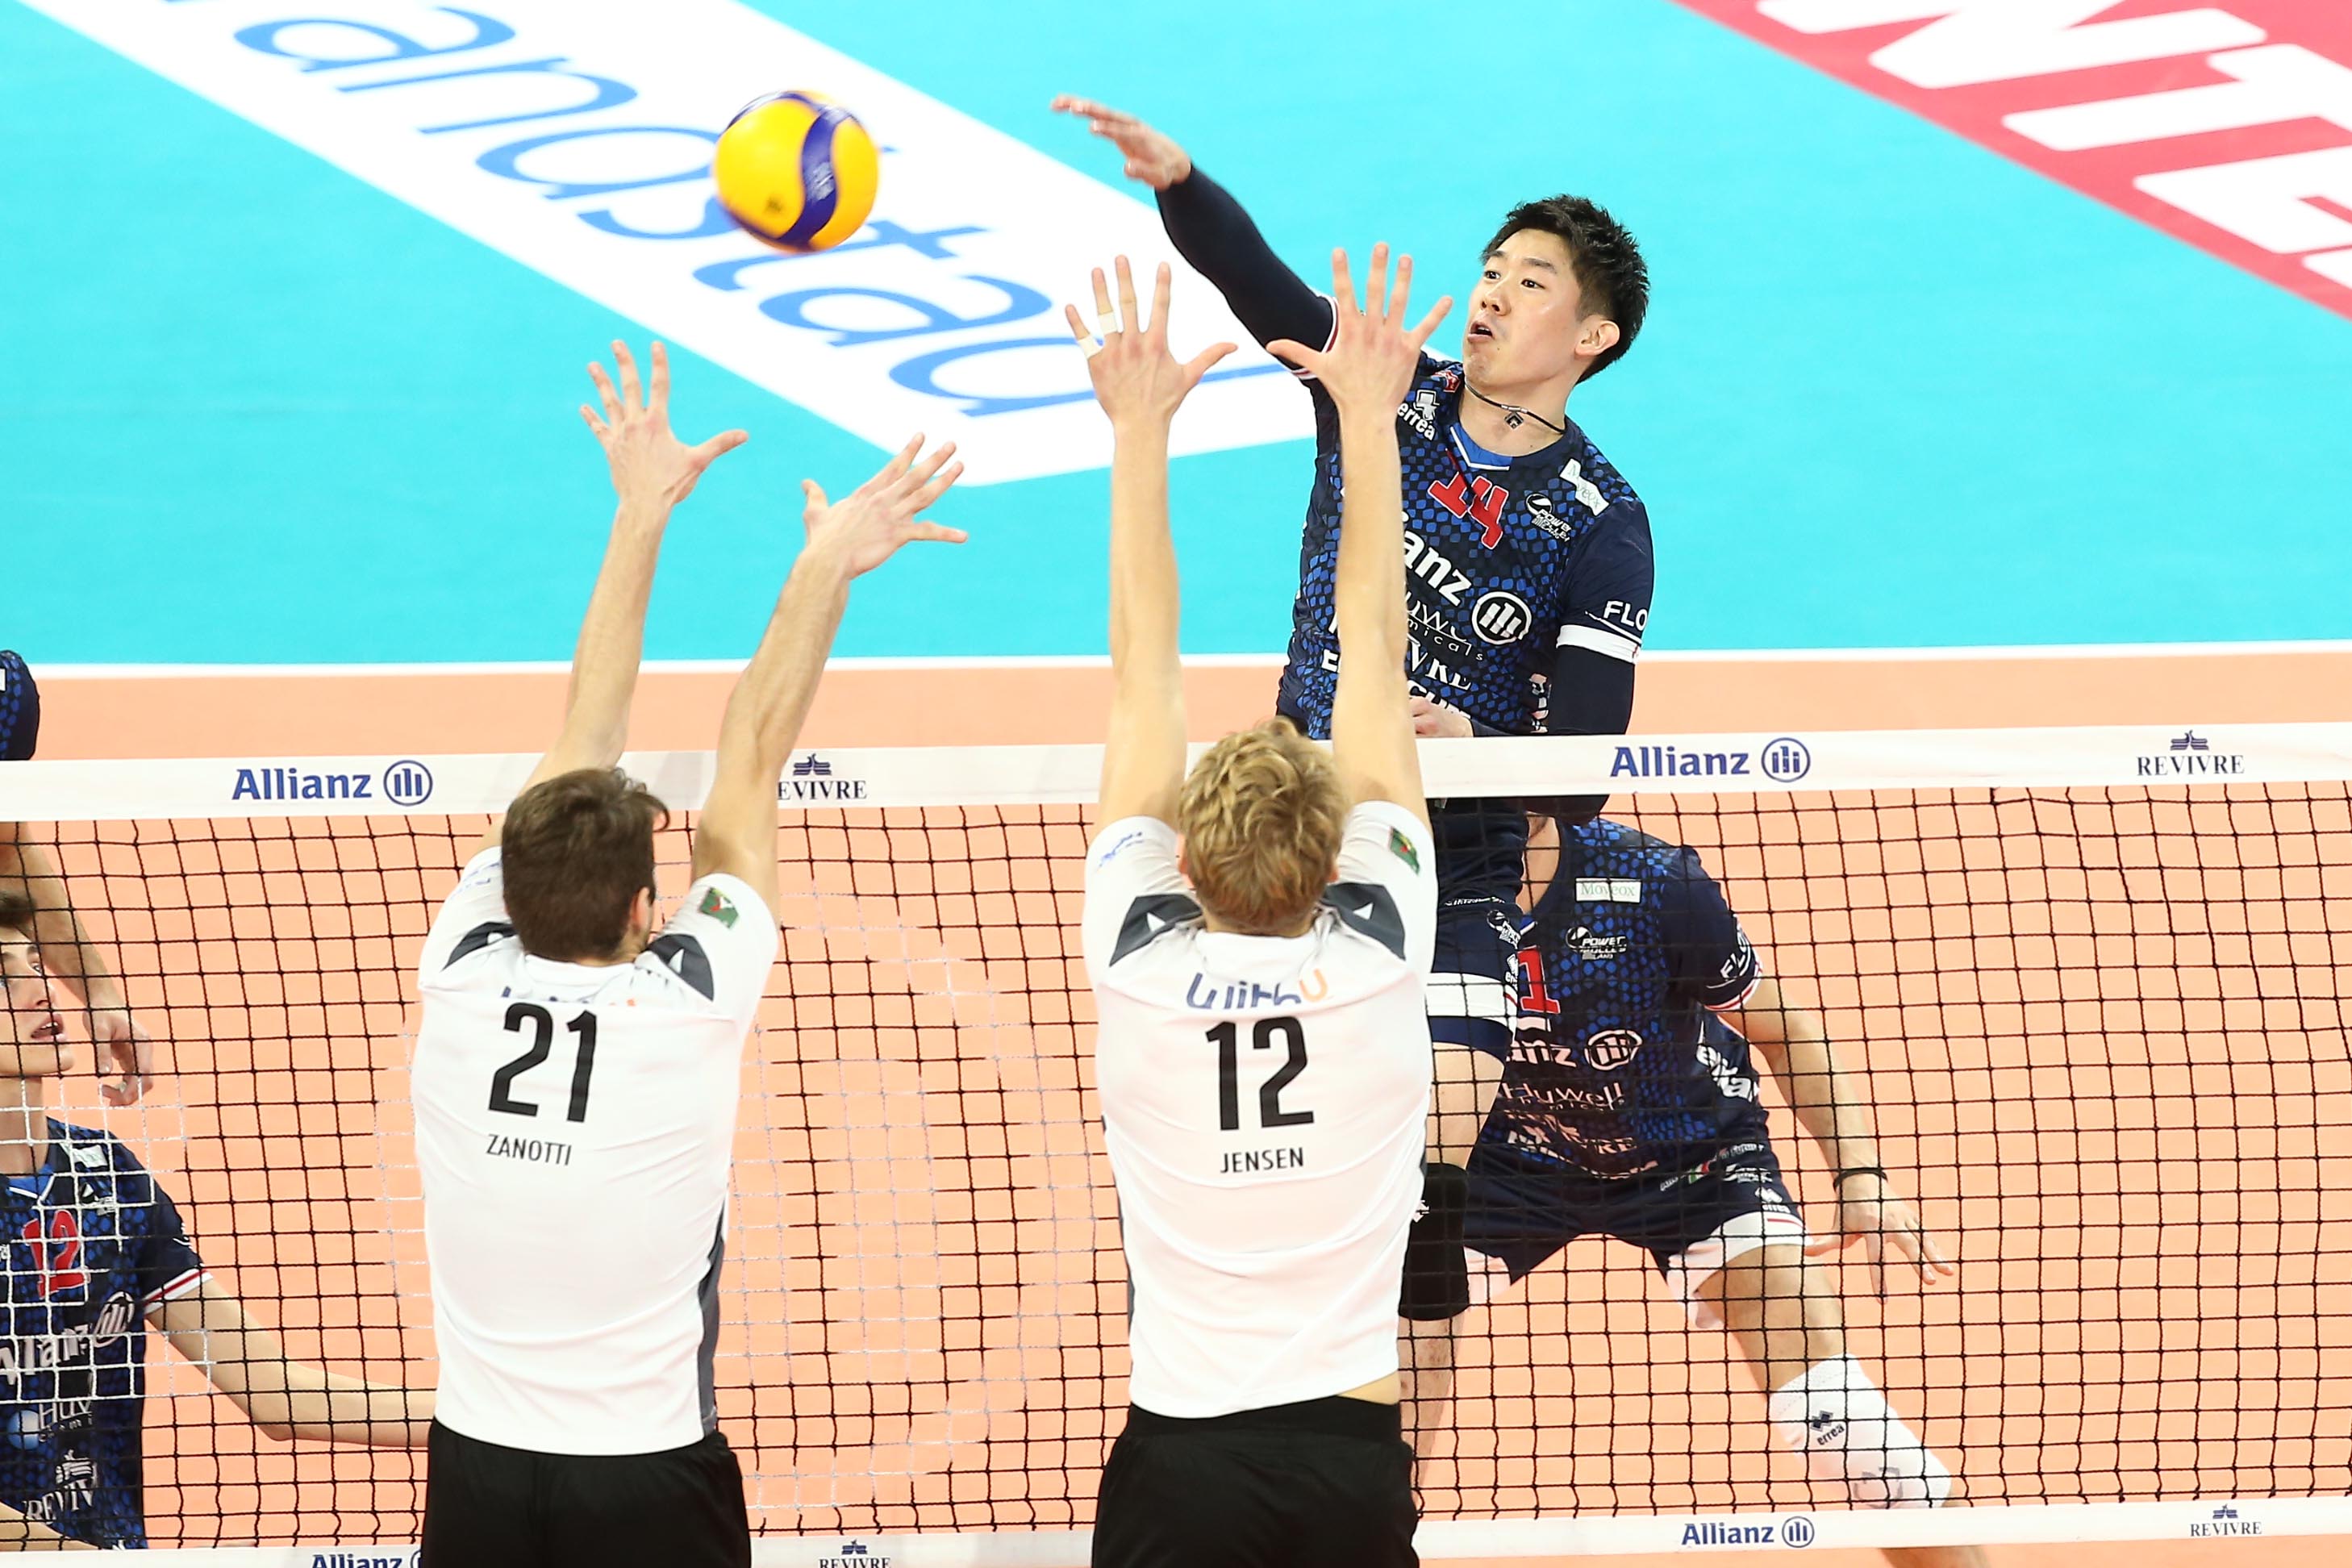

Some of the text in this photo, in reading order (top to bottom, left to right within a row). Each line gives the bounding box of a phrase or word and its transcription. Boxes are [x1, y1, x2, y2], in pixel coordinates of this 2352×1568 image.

[1427, 466, 1509, 549] 14
[1609, 746, 1750, 778] Allianz
[2137, 753, 2245, 777] REVIVRE
[231, 768, 372, 799] Allianz
[778, 780, 868, 800] EVIVRE
[488, 1002, 597, 1123] 21
[1206, 1016, 1314, 1131] 12
[486, 1134, 572, 1166] ZANOTTI
[1220, 1147, 1304, 1174] JENSEN
[23, 1209, 91, 1300] 12
[1681, 1522, 1774, 1545] Allianz
[2190, 1521, 2262, 1537] REVIVRE
[311, 1553, 402, 1568] Allianz
